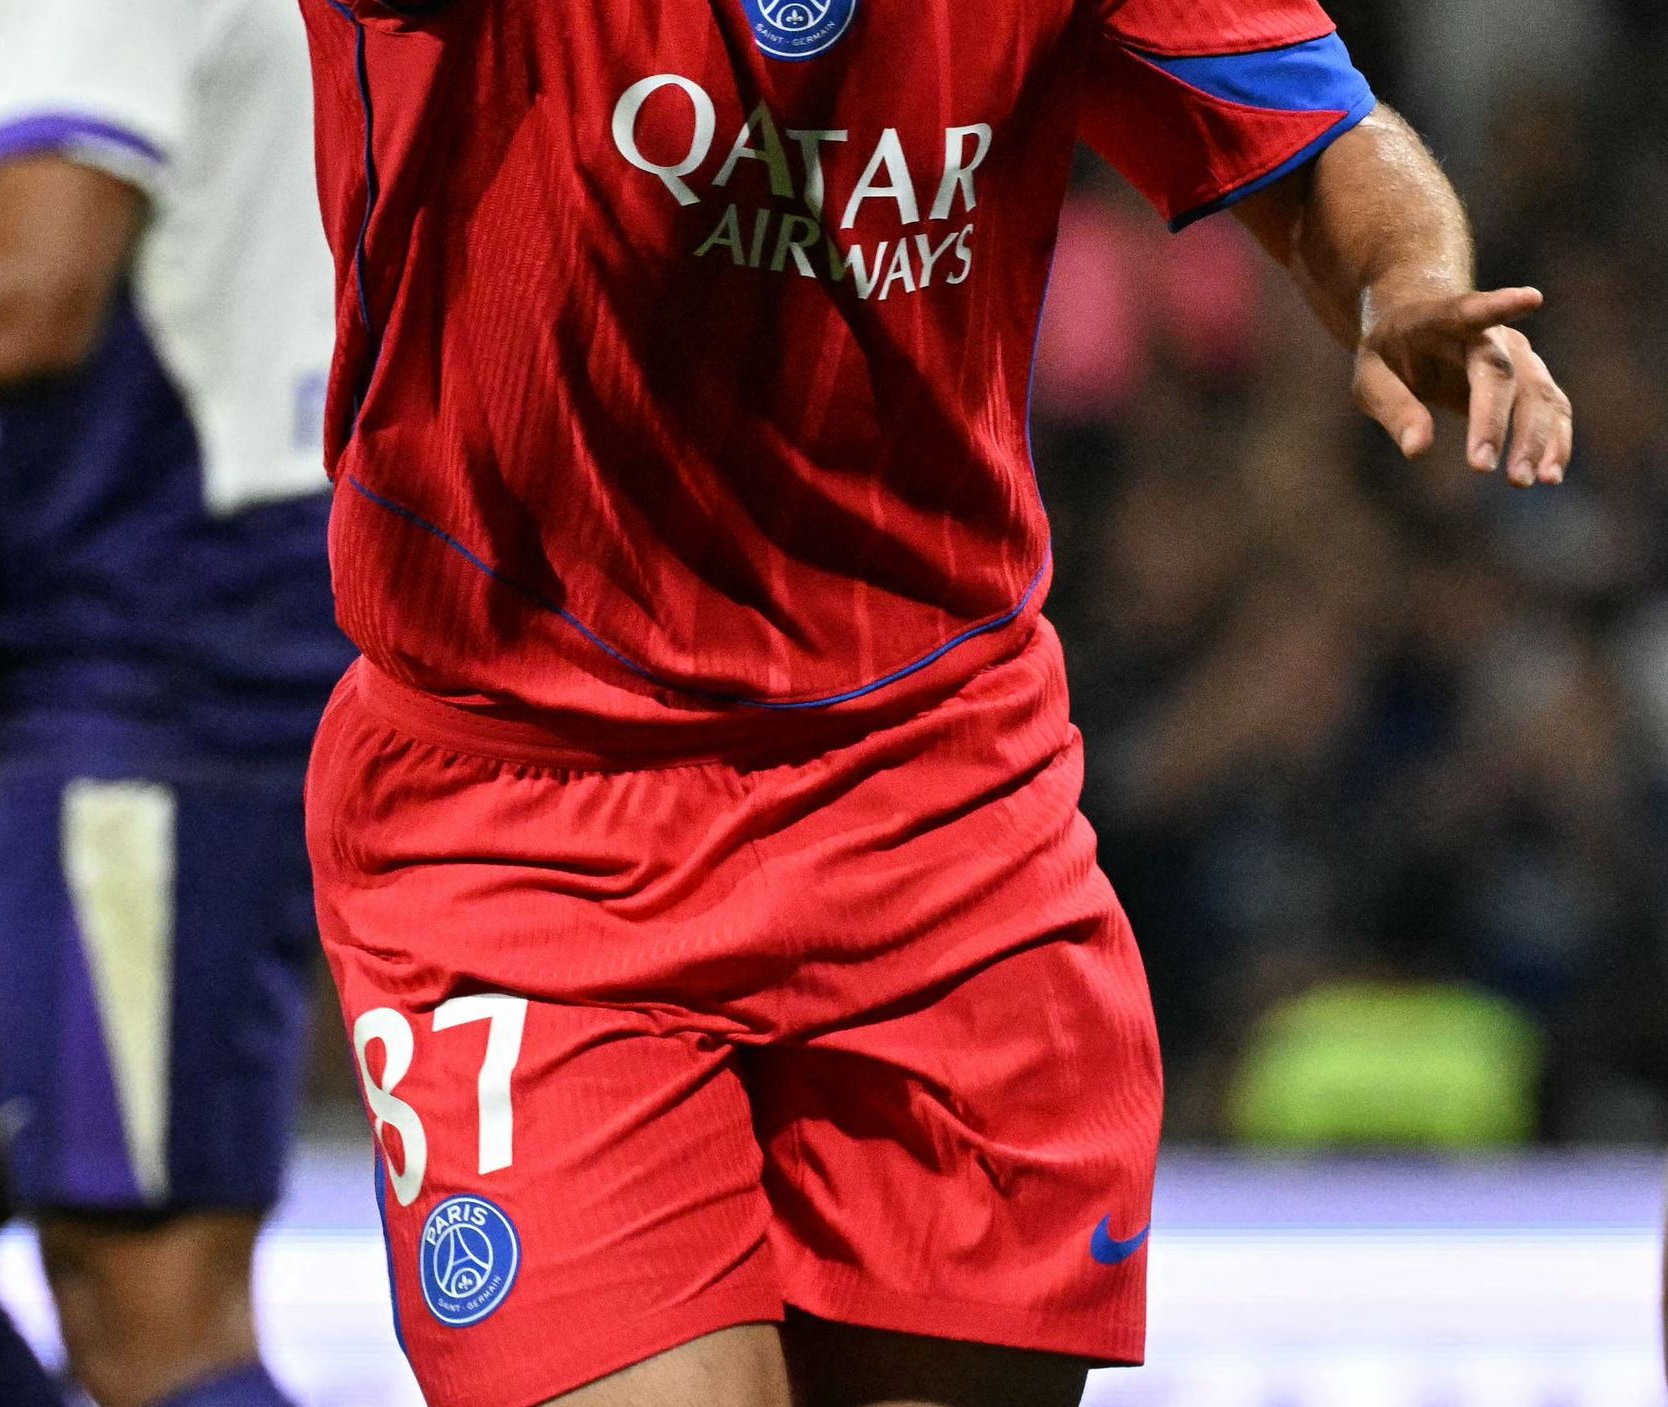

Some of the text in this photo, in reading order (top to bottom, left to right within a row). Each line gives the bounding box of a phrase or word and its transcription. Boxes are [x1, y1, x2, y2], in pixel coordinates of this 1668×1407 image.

[755, 20, 836, 46] SAINT GERMAIN
[611, 73, 993, 230] QATAR
[694, 204, 974, 300] AIRWAYS
[353, 993, 529, 1207] 87
[426, 1204, 488, 1245] PARIS
